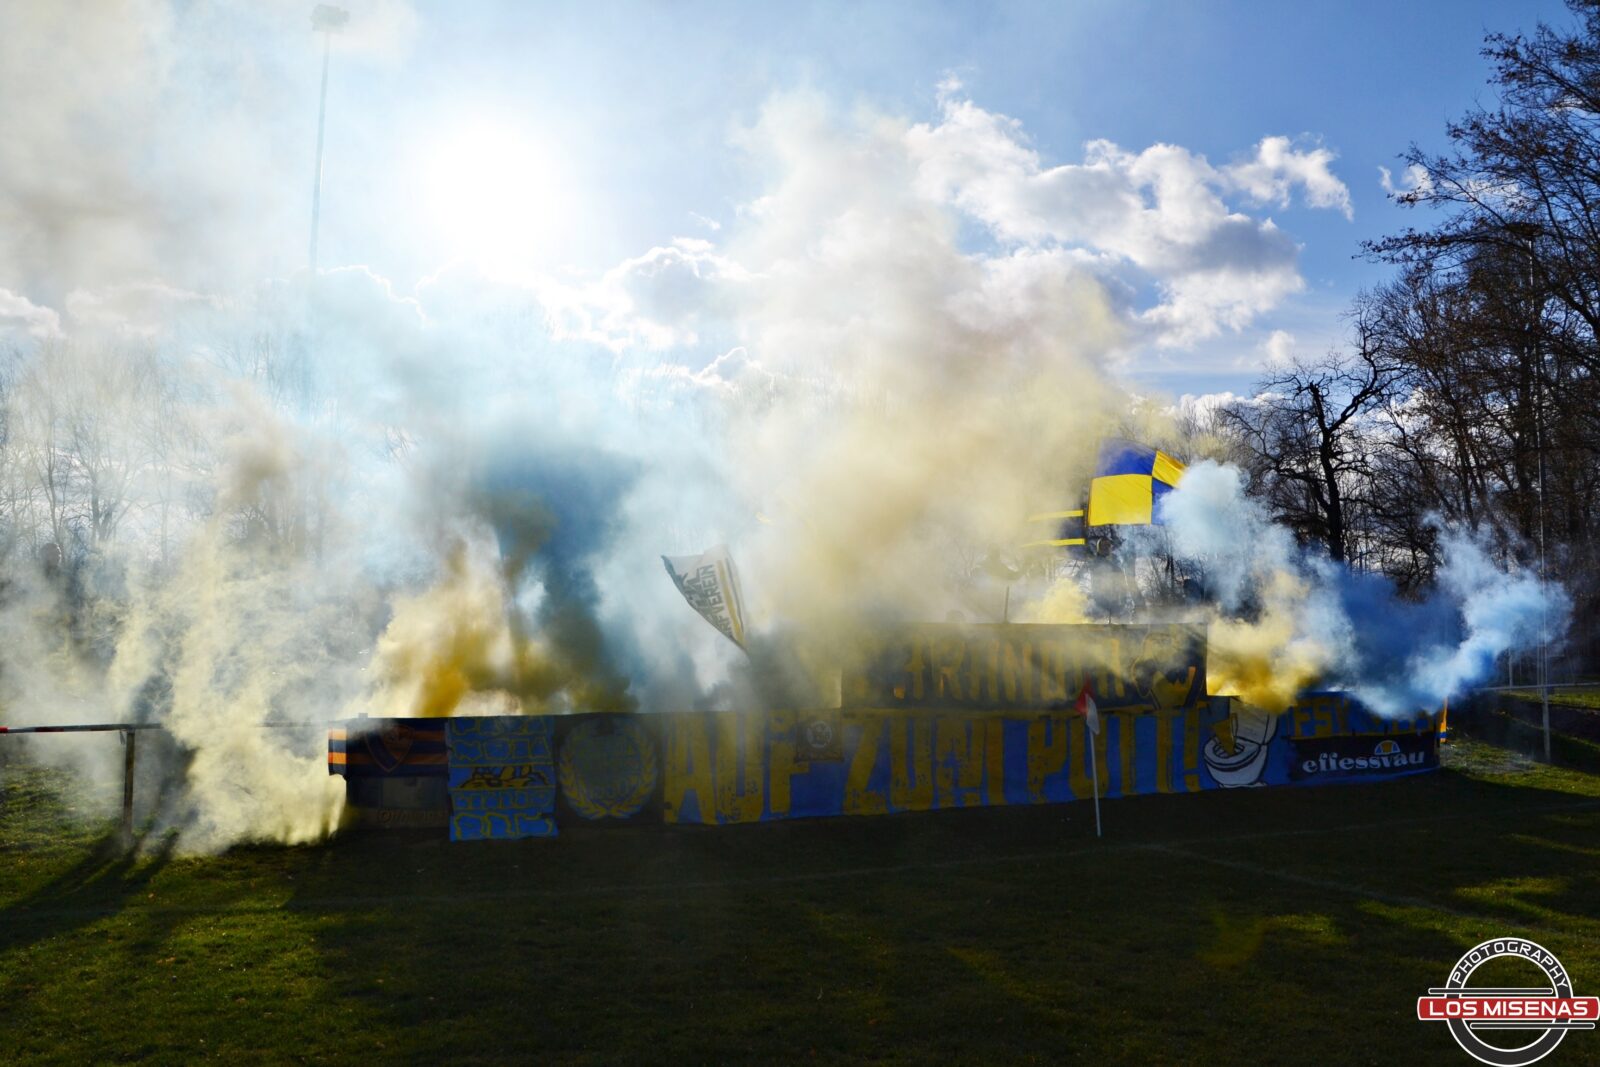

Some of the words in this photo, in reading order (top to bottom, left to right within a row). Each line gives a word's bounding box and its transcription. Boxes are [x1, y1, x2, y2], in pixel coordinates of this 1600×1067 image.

[663, 711, 810, 824] AUF
[842, 714, 1006, 815] ZUM
[1027, 709, 1200, 804] POTT!
[1301, 751, 1425, 774] effessvau
